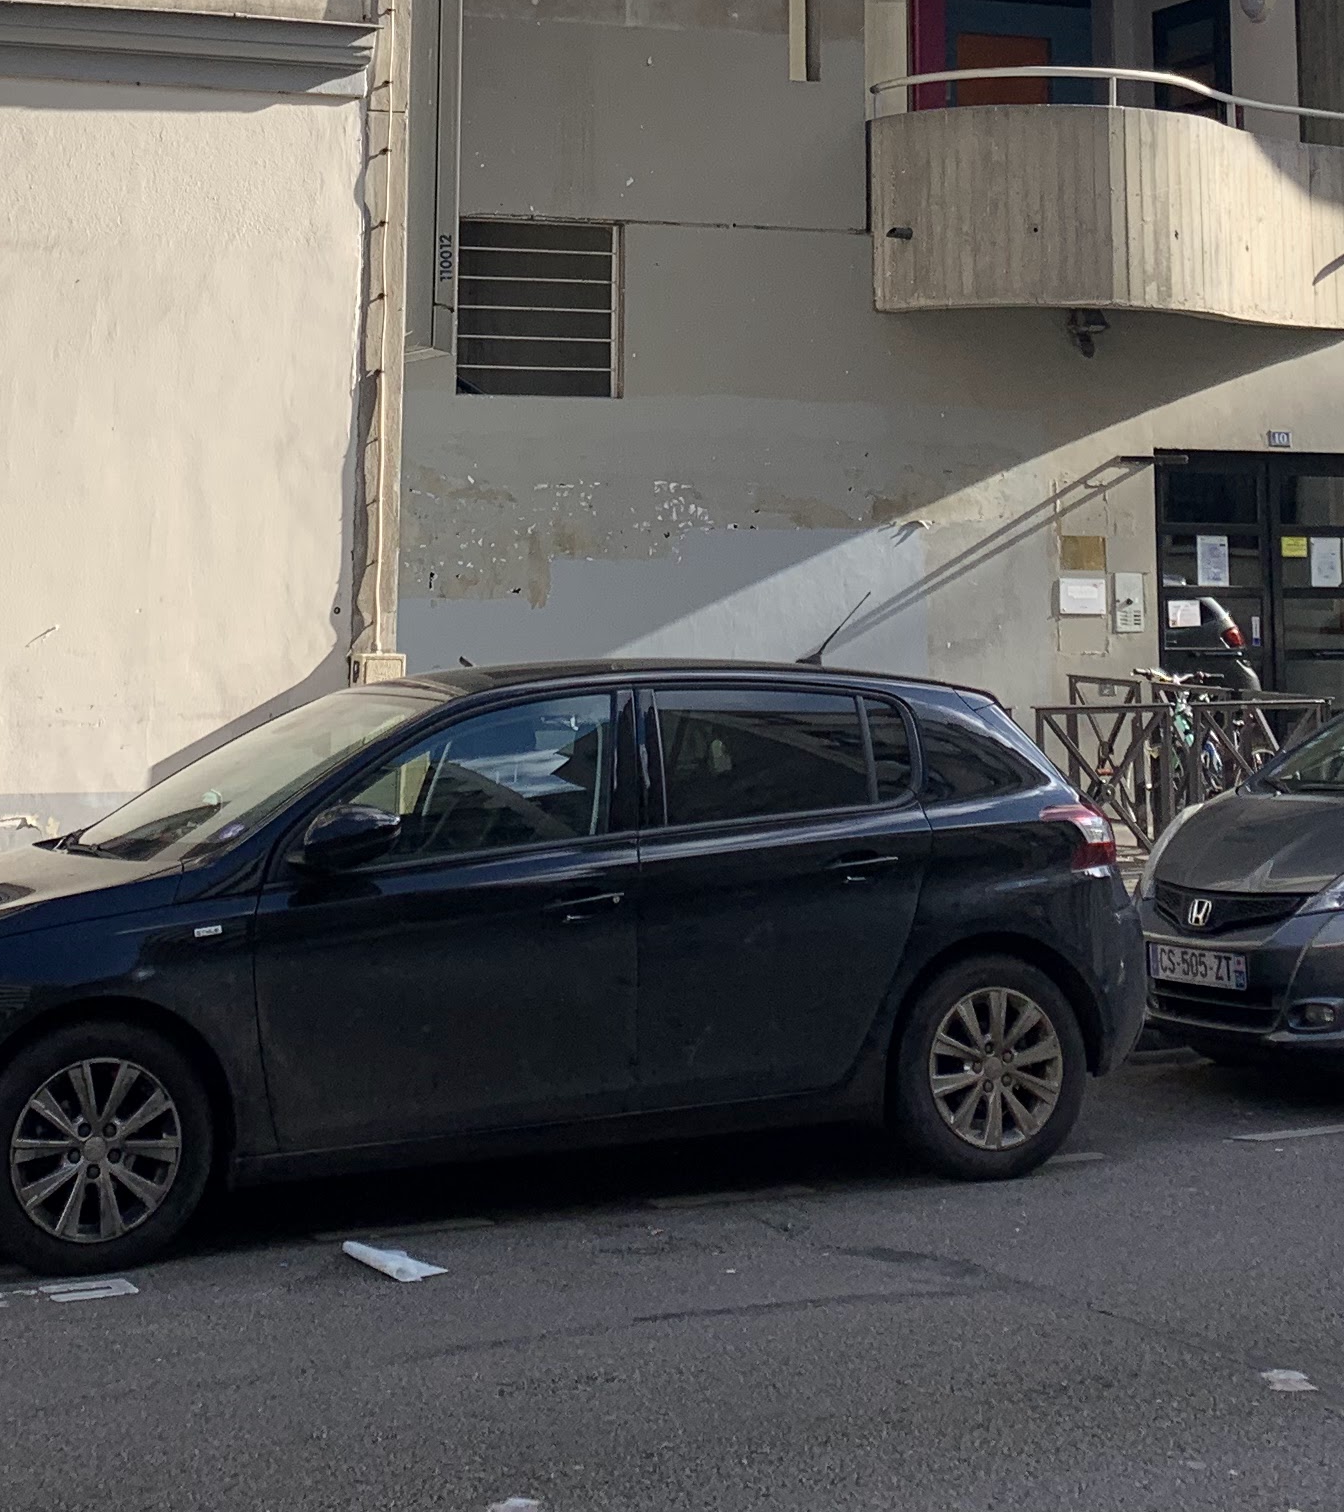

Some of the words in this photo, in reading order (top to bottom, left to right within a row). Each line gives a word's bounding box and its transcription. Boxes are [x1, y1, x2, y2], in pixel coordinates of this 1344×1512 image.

[439, 234, 452, 283] 110012
[1274, 432, 1288, 445] 10
[1159, 947, 1233, 982] CS-505-ZT
